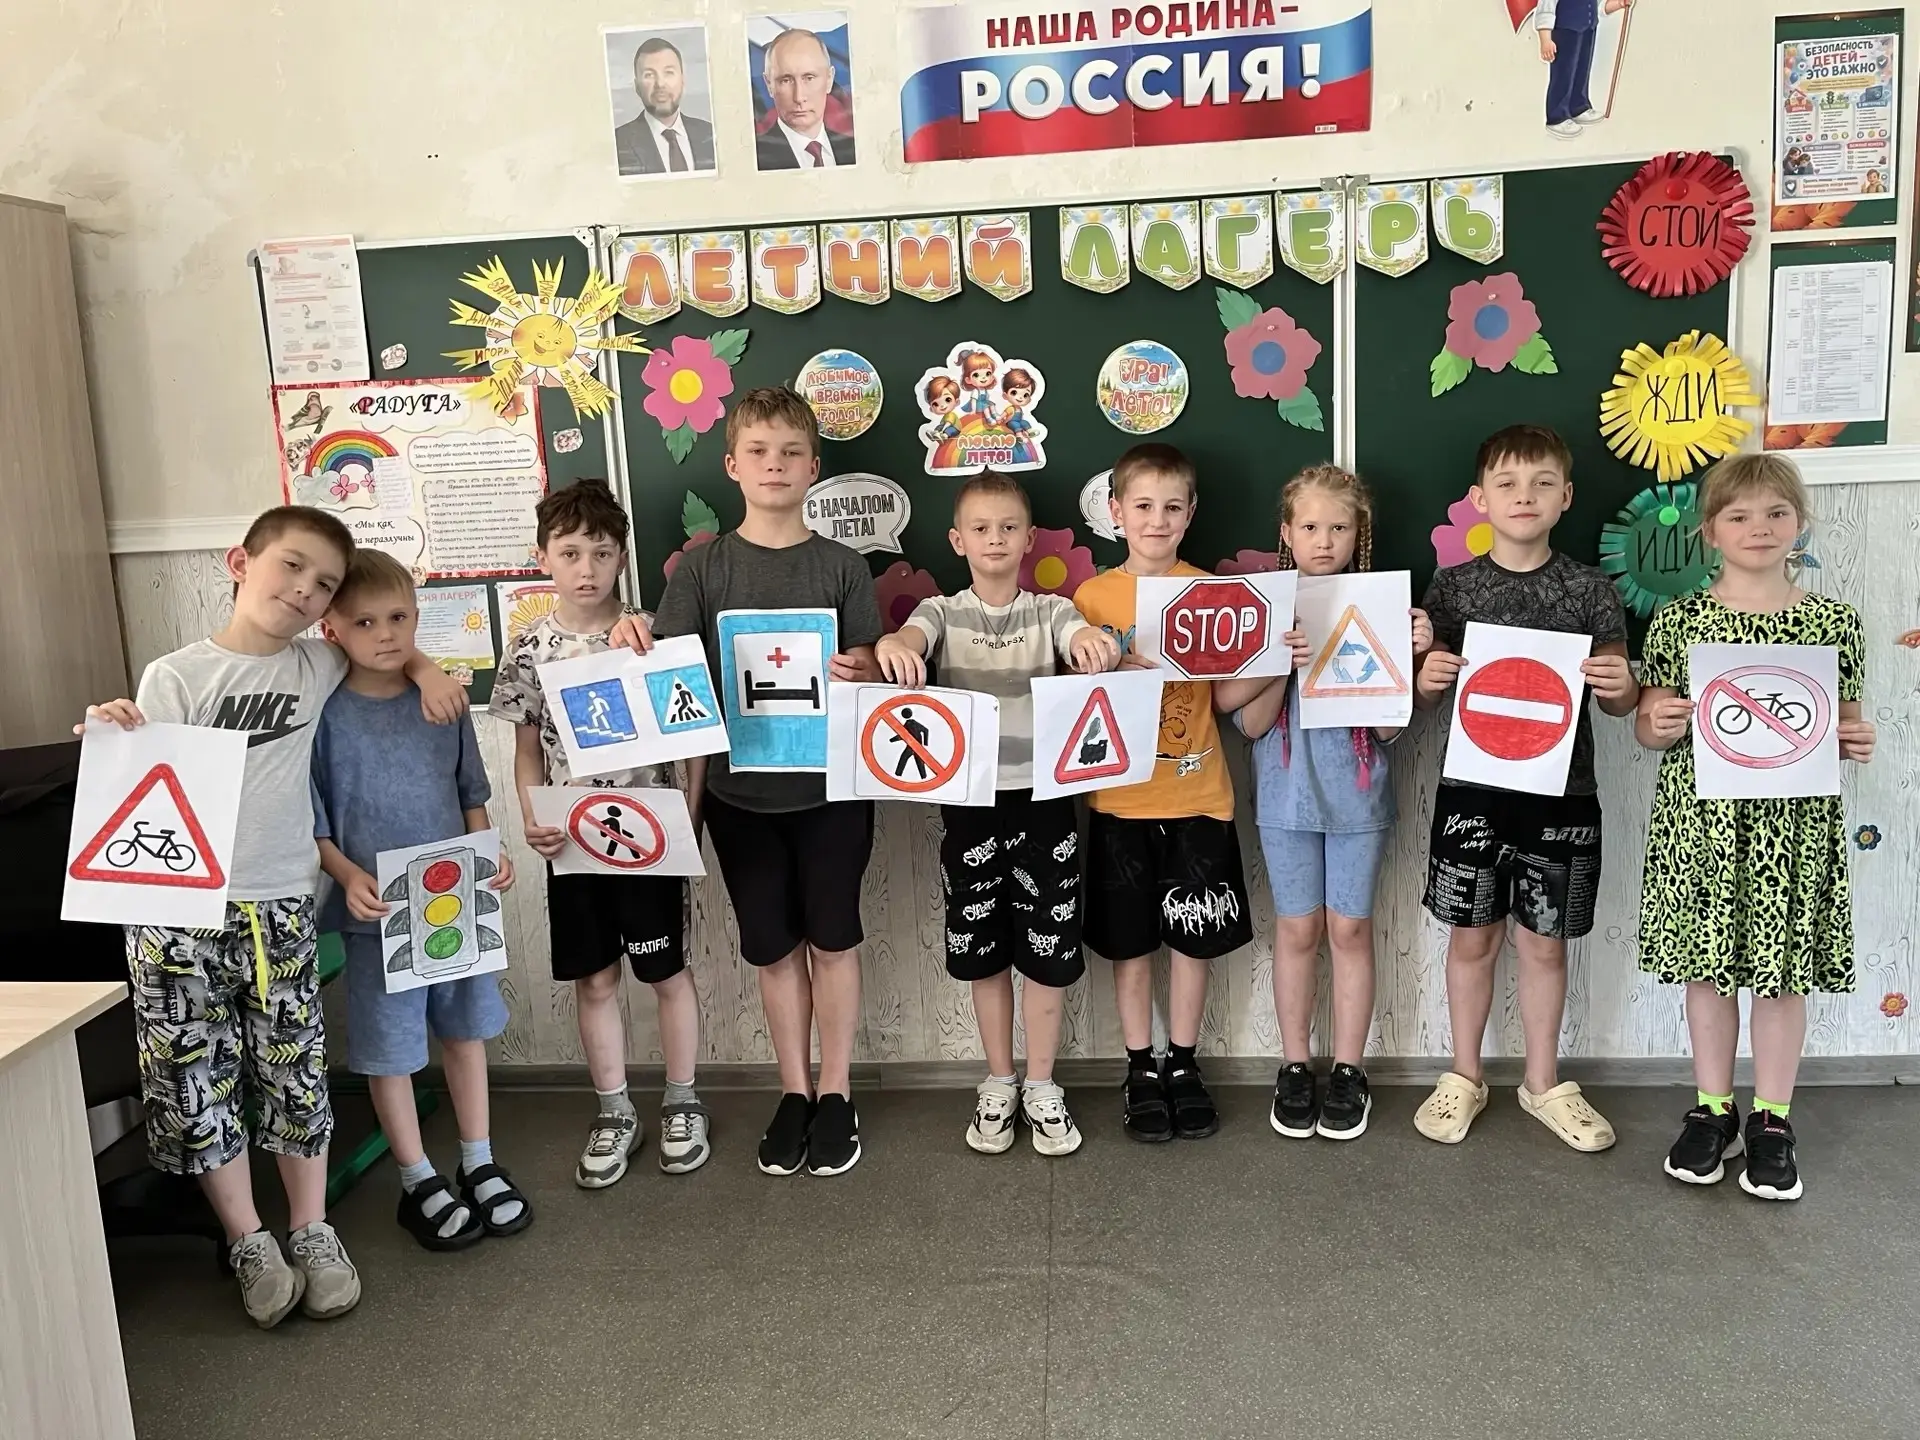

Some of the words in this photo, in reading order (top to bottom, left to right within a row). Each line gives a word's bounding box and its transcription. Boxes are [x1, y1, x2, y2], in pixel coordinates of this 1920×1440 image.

[986, 10, 1098, 48] НАША
[1805, 41, 1873, 57] БЕЗОПАСНОСТЬ
[1806, 69, 1829, 80] ЭТО
[1832, 63, 1876, 76] ВАЖНО
[960, 43, 1321, 124] РОССИЯ!
[1640, 202, 1721, 249] СТОЙ
[622, 218, 1026, 309] ЛЕТНИЙ
[1068, 196, 1497, 280] ЛАГЕРЬ
[539, 280, 555, 304] ВИКА
[575, 283, 602, 317] СОФИЯ
[466, 310, 505, 328] ДИМА
[597, 336, 634, 350] МАКСИМ
[475, 347, 509, 364] ИГОРЬ
[349, 394, 461, 416] «РАДУГА»
[1640, 367, 1721, 425] ЖДИ
[965, 450, 1013, 465] ЛЕТО!
[807, 500, 818, 519] С
[821, 494, 895, 519] НАЧАЛОМ
[377, 521, 395, 529] как
[832, 517, 876, 539] ЛЕТА!
[365, 536, 415, 547] неразлучны
[1636, 526, 1705, 575] ИДИ
[440, 591, 477, 601] ЛАГЕРЯ
[1173, 606, 1258, 654] STOP
[212, 692, 300, 730] NIKE
[628, 936, 669, 954] BEATIFIC
